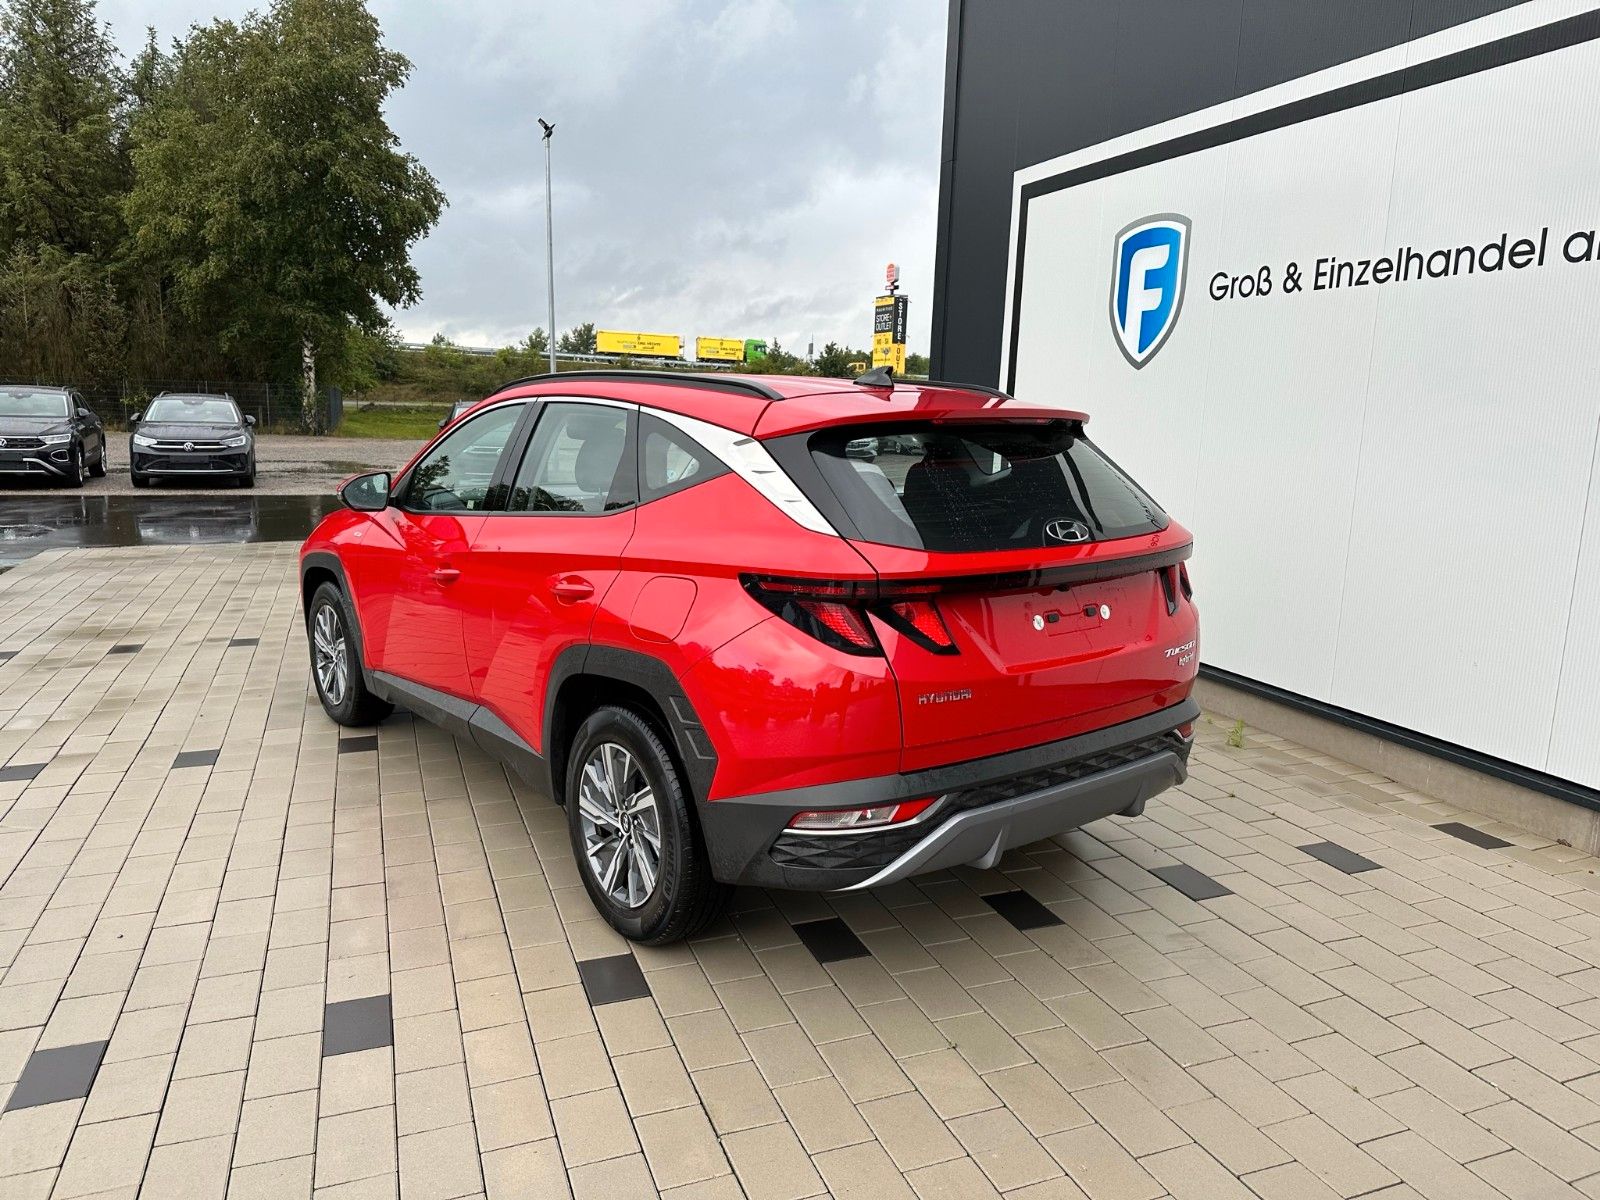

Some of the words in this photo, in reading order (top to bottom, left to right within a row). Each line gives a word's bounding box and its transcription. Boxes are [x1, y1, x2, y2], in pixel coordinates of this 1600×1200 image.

[1209, 256, 1273, 301] Groß
[1282, 261, 1303, 294] &
[1313, 227, 1549, 291] Einzelhandel
[1562, 230, 1600, 264] a
[918, 688, 973, 705] HYUNDAI
